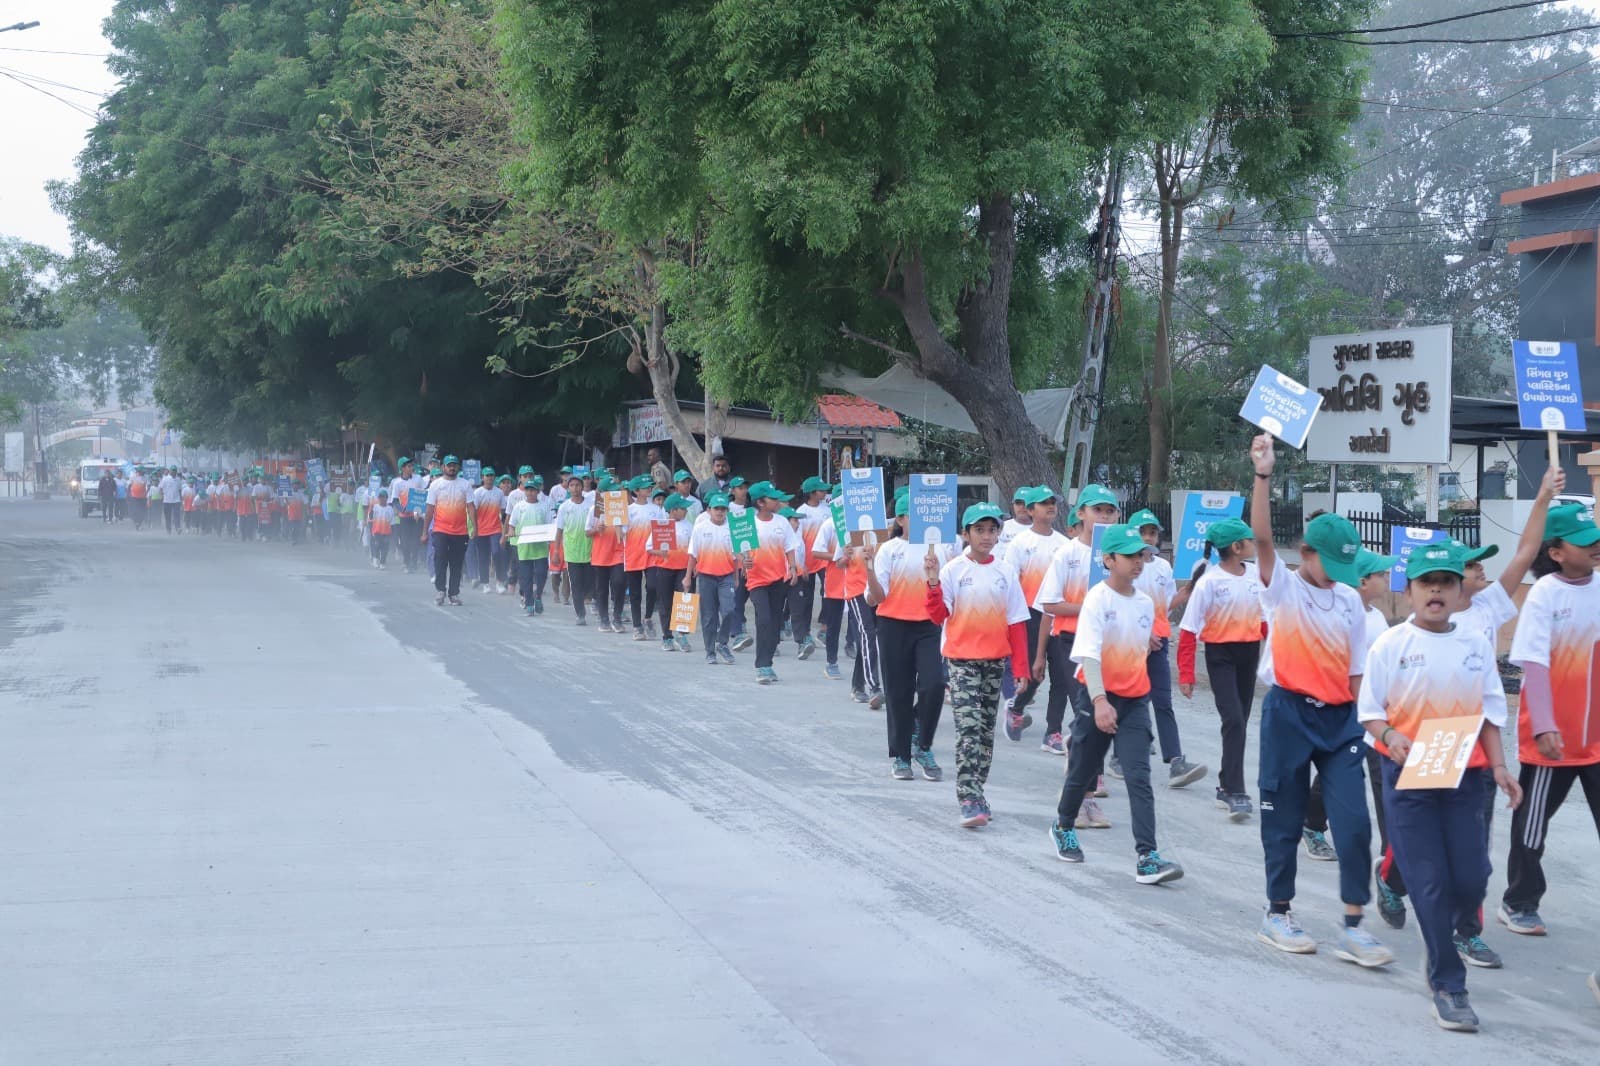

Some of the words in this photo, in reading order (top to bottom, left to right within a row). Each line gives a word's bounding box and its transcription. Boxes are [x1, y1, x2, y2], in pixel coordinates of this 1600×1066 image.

[1333, 343, 1372, 371] ગુજરાત
[1375, 340, 1414, 360] સરકાર
[1317, 372, 1383, 412] અતિથિ
[1392, 381, 1430, 426] ગૃહ
